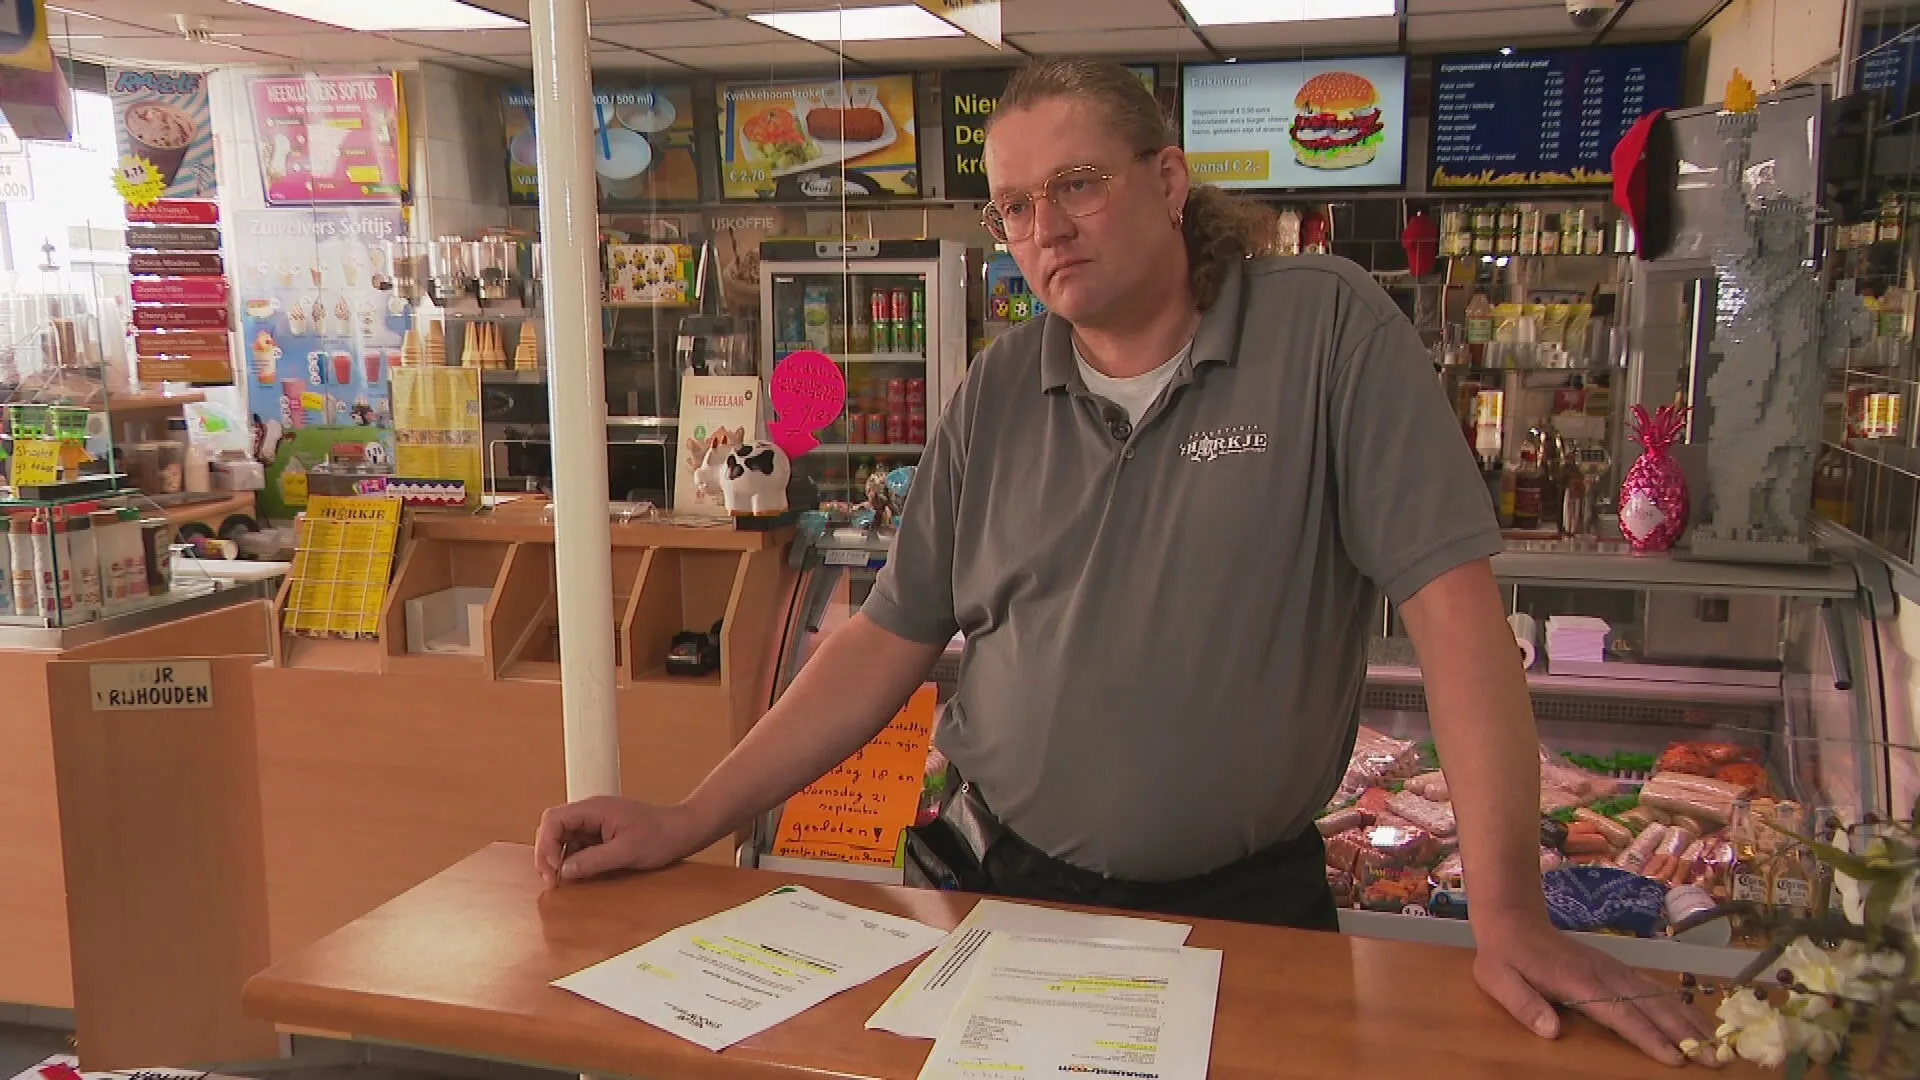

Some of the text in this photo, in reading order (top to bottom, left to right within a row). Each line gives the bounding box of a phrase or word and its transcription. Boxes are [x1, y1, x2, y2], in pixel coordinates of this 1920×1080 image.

[617, 94, 635, 105] 500
[723, 88, 826, 102] Kwekkeboomkroket
[956, 125, 985, 145] De
[1192, 159, 1229, 173] vanaf
[729, 169, 765, 183] € 2,70
[340, 216, 393, 239] Softijs
[694, 394, 745, 407] TWIJFELAAR
